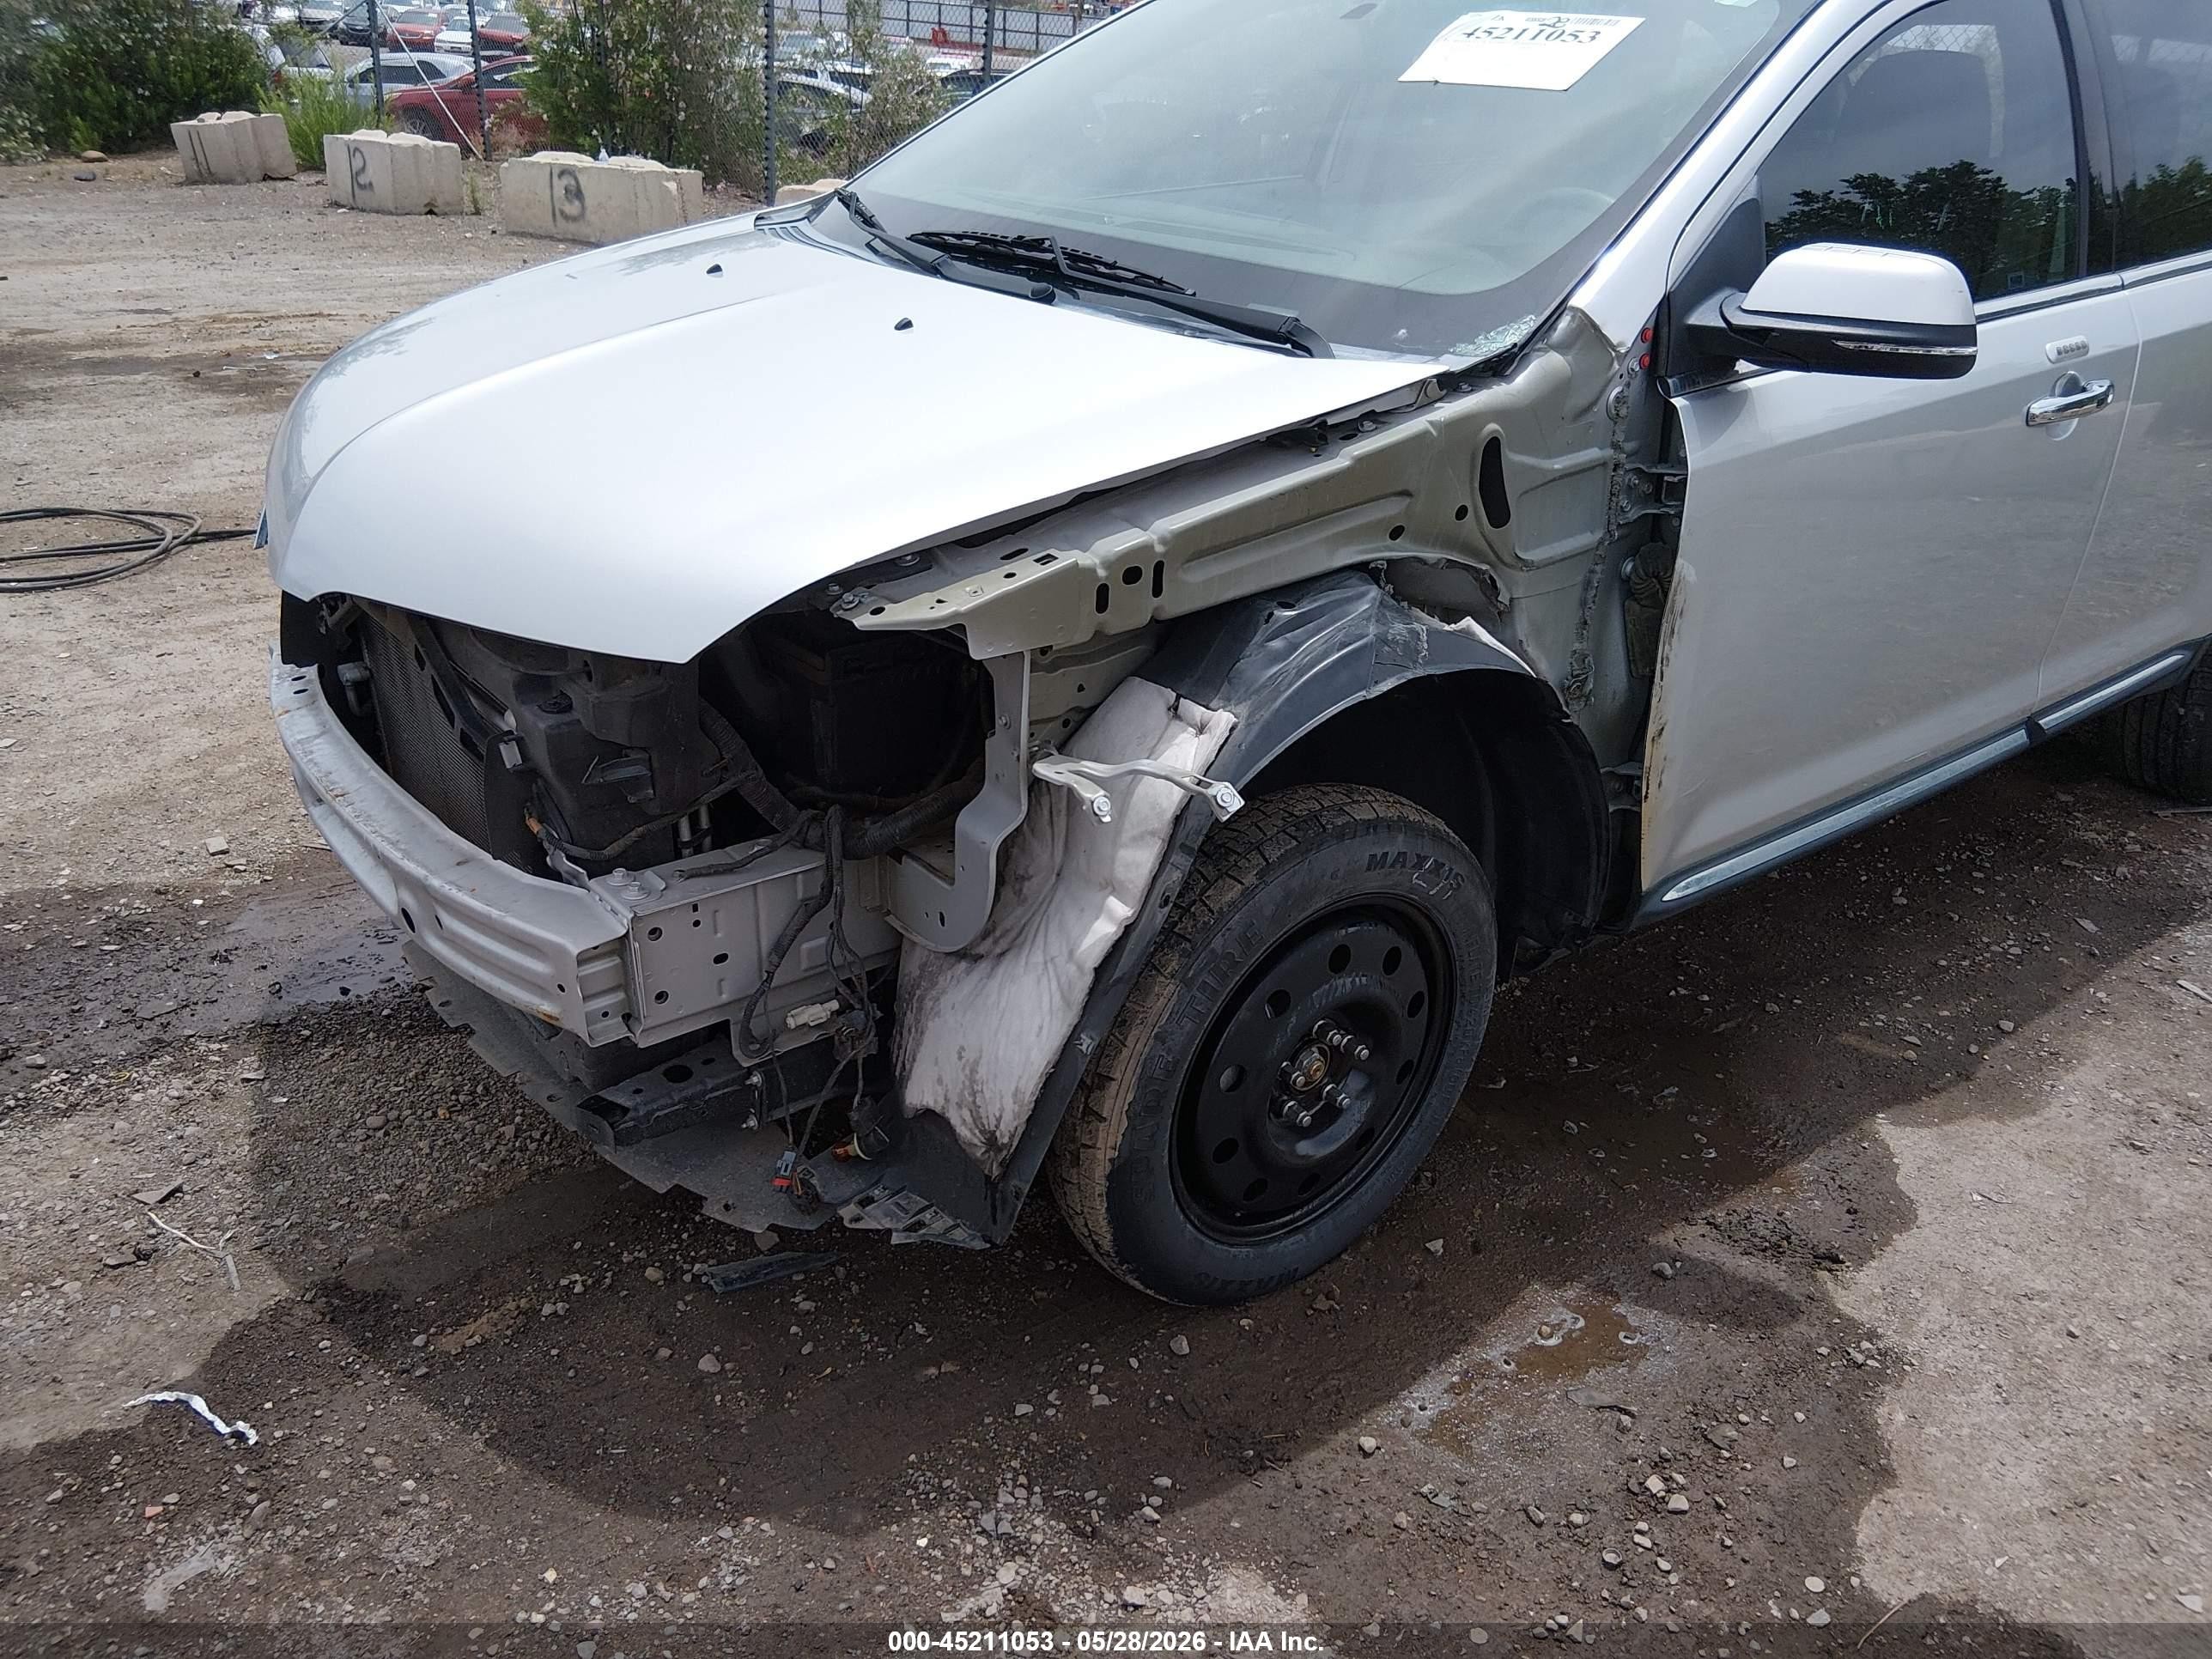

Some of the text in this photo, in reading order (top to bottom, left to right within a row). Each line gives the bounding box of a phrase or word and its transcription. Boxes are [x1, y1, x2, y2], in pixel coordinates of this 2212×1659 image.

[1462, 27, 1601, 44] 45211053
[187, 130, 213, 177] 11
[347, 143, 374, 208] 12
[549, 165, 586, 227] 13
[1364, 851, 1465, 890] MAXXIS
[1175, 920, 1265, 1027] TIRE
